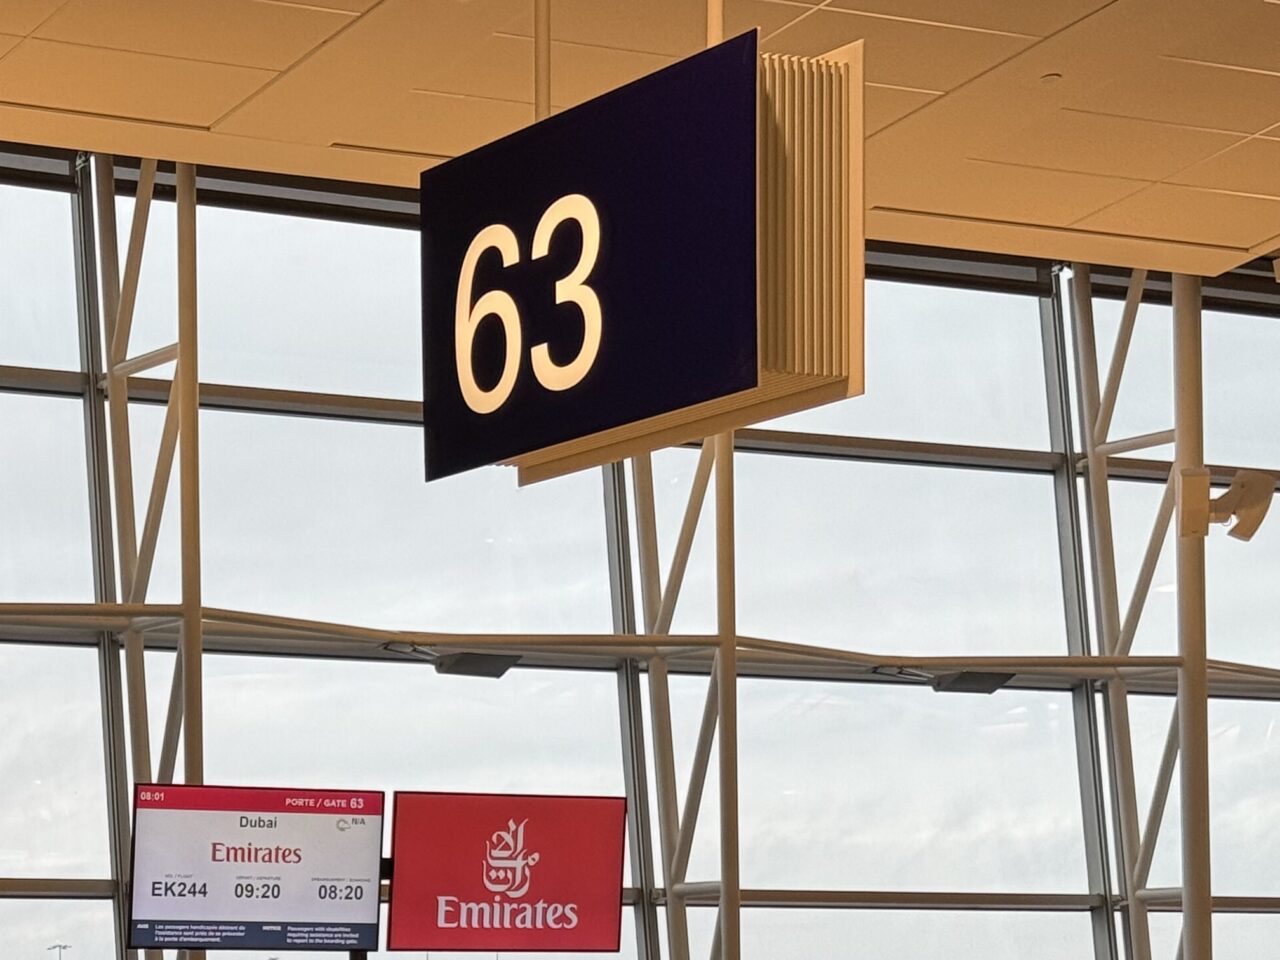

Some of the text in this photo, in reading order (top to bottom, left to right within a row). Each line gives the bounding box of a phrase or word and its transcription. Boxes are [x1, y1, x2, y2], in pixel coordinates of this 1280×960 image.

[455, 193, 602, 414] 63
[140, 791, 165, 802] 08:01
[285, 798, 314, 808] PORTE
[323, 800, 347, 809] GATE
[350, 798, 364, 810] 63
[239, 816, 278, 829] Dubai
[211, 842, 302, 864] Emirates
[151, 881, 208, 898] EK244
[234, 883, 281, 899] 09:20
[318, 885, 364, 900] 08:20
[436, 895, 578, 929] Emirates
